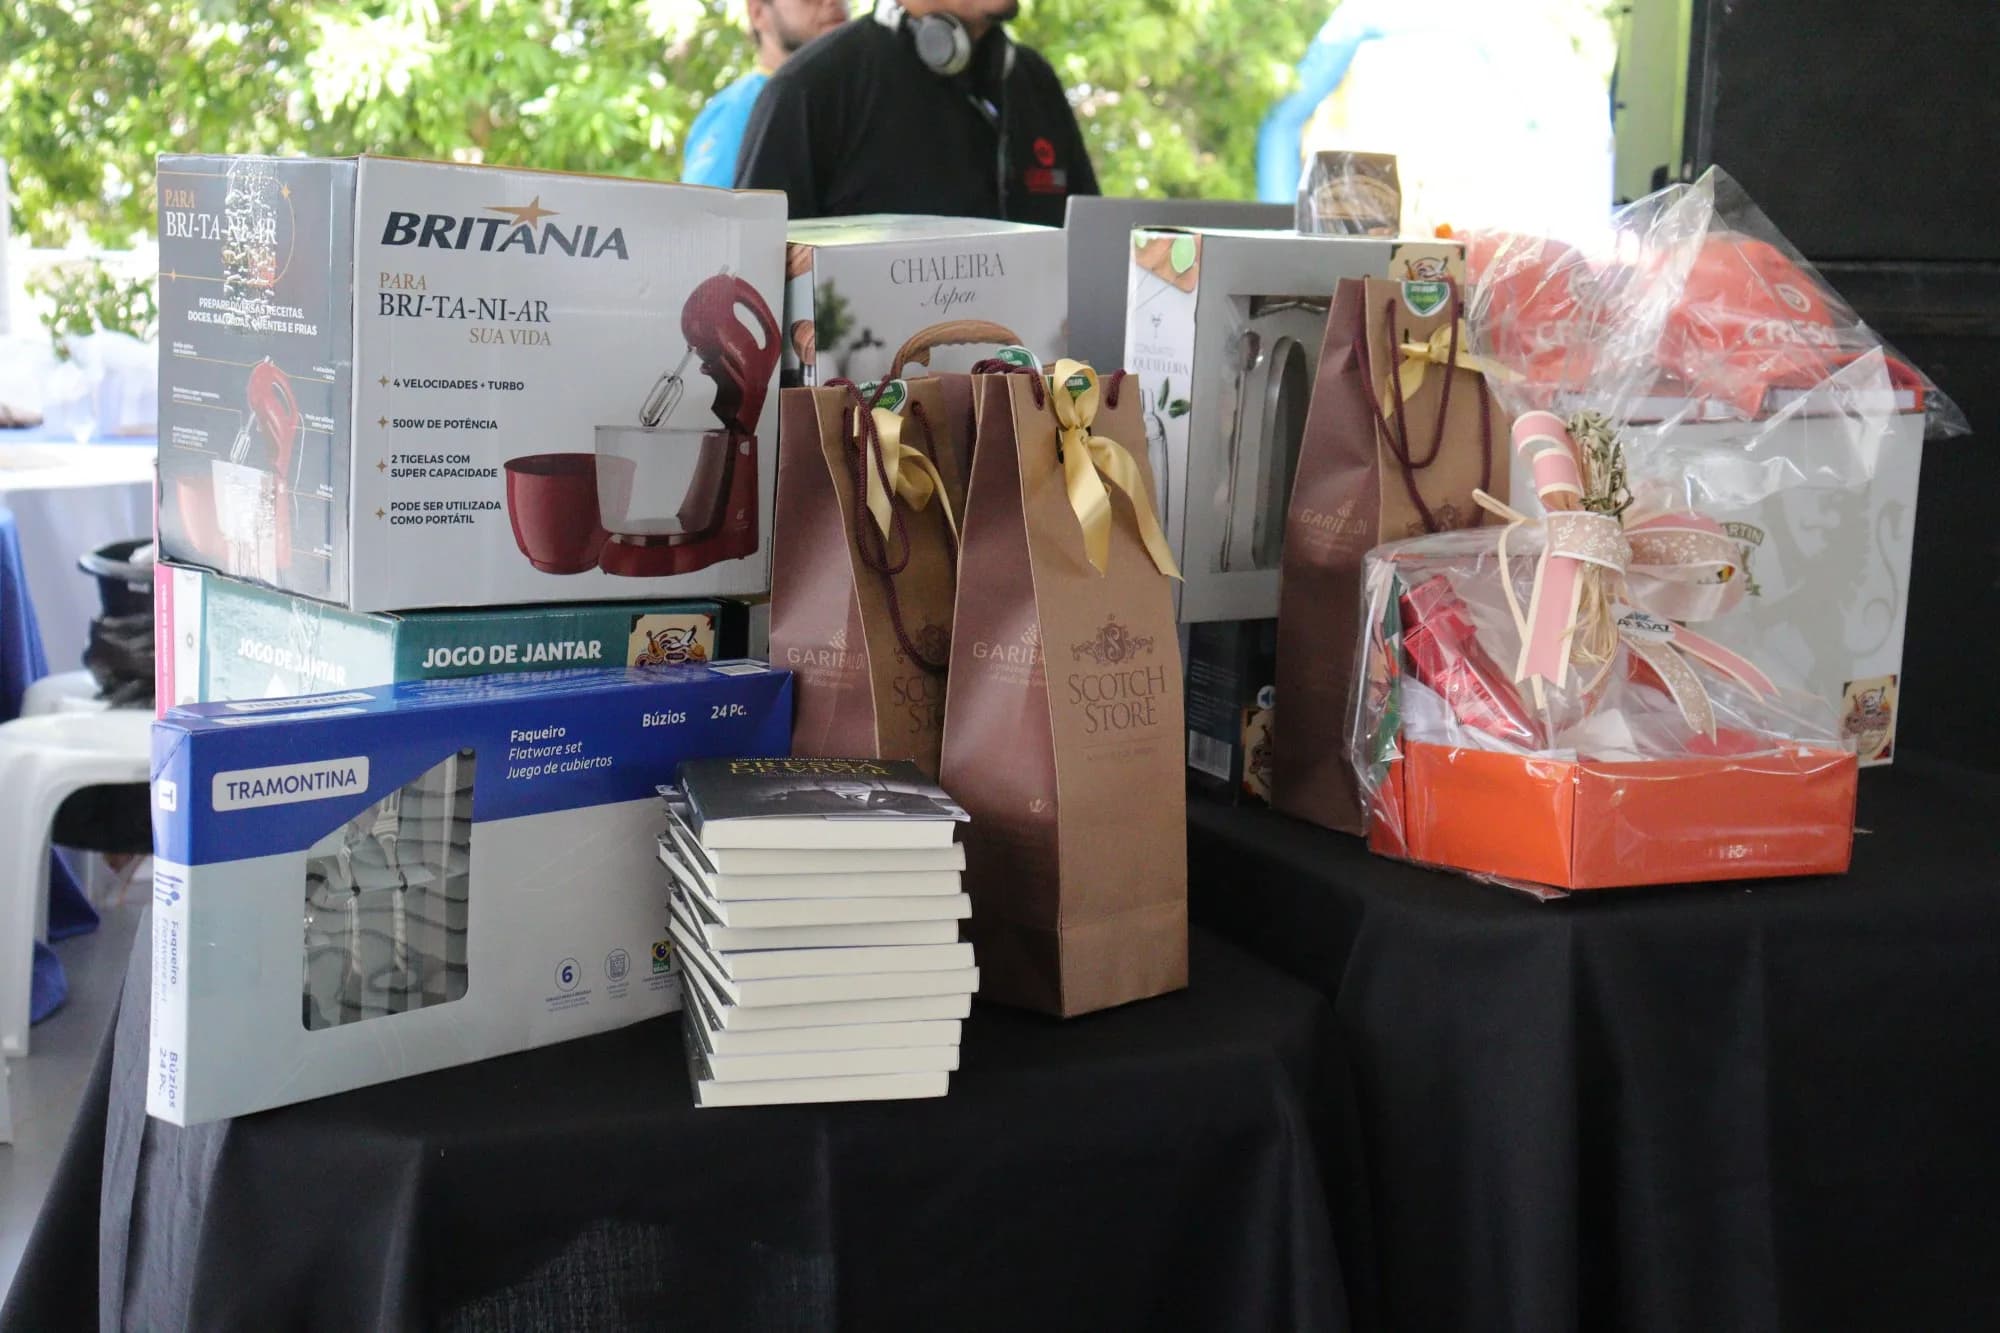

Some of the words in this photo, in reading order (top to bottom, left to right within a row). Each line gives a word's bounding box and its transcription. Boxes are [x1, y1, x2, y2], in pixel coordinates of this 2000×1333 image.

[164, 189, 195, 208] PARA
[890, 253, 1005, 285] CHALEIRA
[380, 272, 427, 290] PARA
[378, 293, 551, 323] BRI-TA-NI-AR
[920, 283, 976, 314] Aspen
[288, 324, 294, 333] E
[295, 325, 317, 336] FRIAS
[469, 328, 504, 344] SUA
[510, 329, 551, 346] VIDA
[393, 378, 400, 388] 4
[403, 379, 478, 390] VELOCIDADES
[488, 381, 524, 391] TURBO
[393, 419, 424, 428] 500W
[427, 419, 441, 428] DE
[444, 418, 498, 429] POTÊNCIA
[391, 455, 397, 463] 2
[399, 455, 444, 464] TIGELAS
[446, 455, 470, 463] COM
[391, 469, 427, 477] SUPER
[429, 469, 498, 477] CAPACIDADE
[391, 502, 420, 511] PODE
[423, 502, 443, 511] SER
[446, 501, 501, 511] UTILIZADA
[390, 516, 423, 525] COMO
[425, 513, 474, 524] PORTÁTIL
[237, 637, 273, 663] JOGO
[275, 649, 292, 669] DE
[295, 653, 346, 686] JANTAR
[422, 647, 486, 669] JOGO
[489, 645, 516, 665] DE
[521, 640, 602, 663] JANTAR
[1068, 665, 1167, 704] SCOTCH
[642, 709, 686, 728] Búzios
[711, 705, 727, 720] 24
[730, 703, 747, 717] Pc.
[1085, 697, 1158, 734] STORE
[511, 725, 565, 743] Faqueiro
[508, 744, 563, 761] Flatware
[564, 741, 582, 755] set
[506, 763, 541, 781] Juego
[544, 761, 558, 774] de
[561, 755, 613, 773] cubiertos
[227, 768, 357, 801] TRAMONTINA
[562, 966, 573, 983] 6
